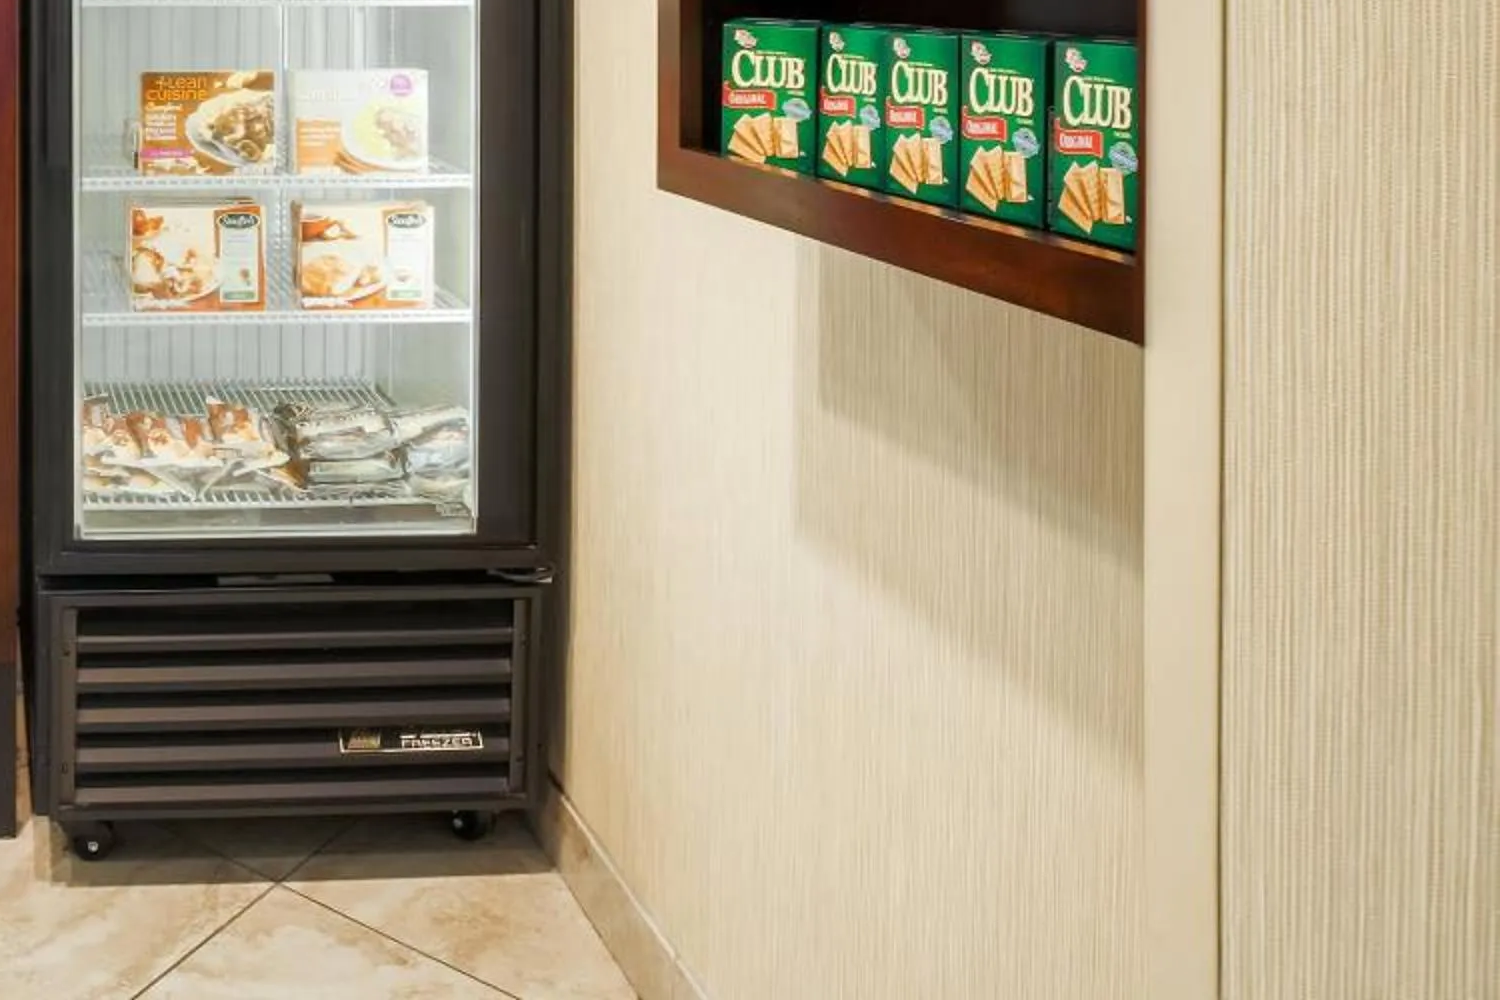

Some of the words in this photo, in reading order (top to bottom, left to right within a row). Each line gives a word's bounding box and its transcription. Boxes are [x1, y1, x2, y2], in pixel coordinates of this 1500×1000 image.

[731, 49, 805, 89] CLUB
[826, 53, 877, 97] CLUB
[891, 60, 948, 107] CLUB
[969, 66, 1034, 117] CLUB
[1063, 75, 1132, 130] CLUB
